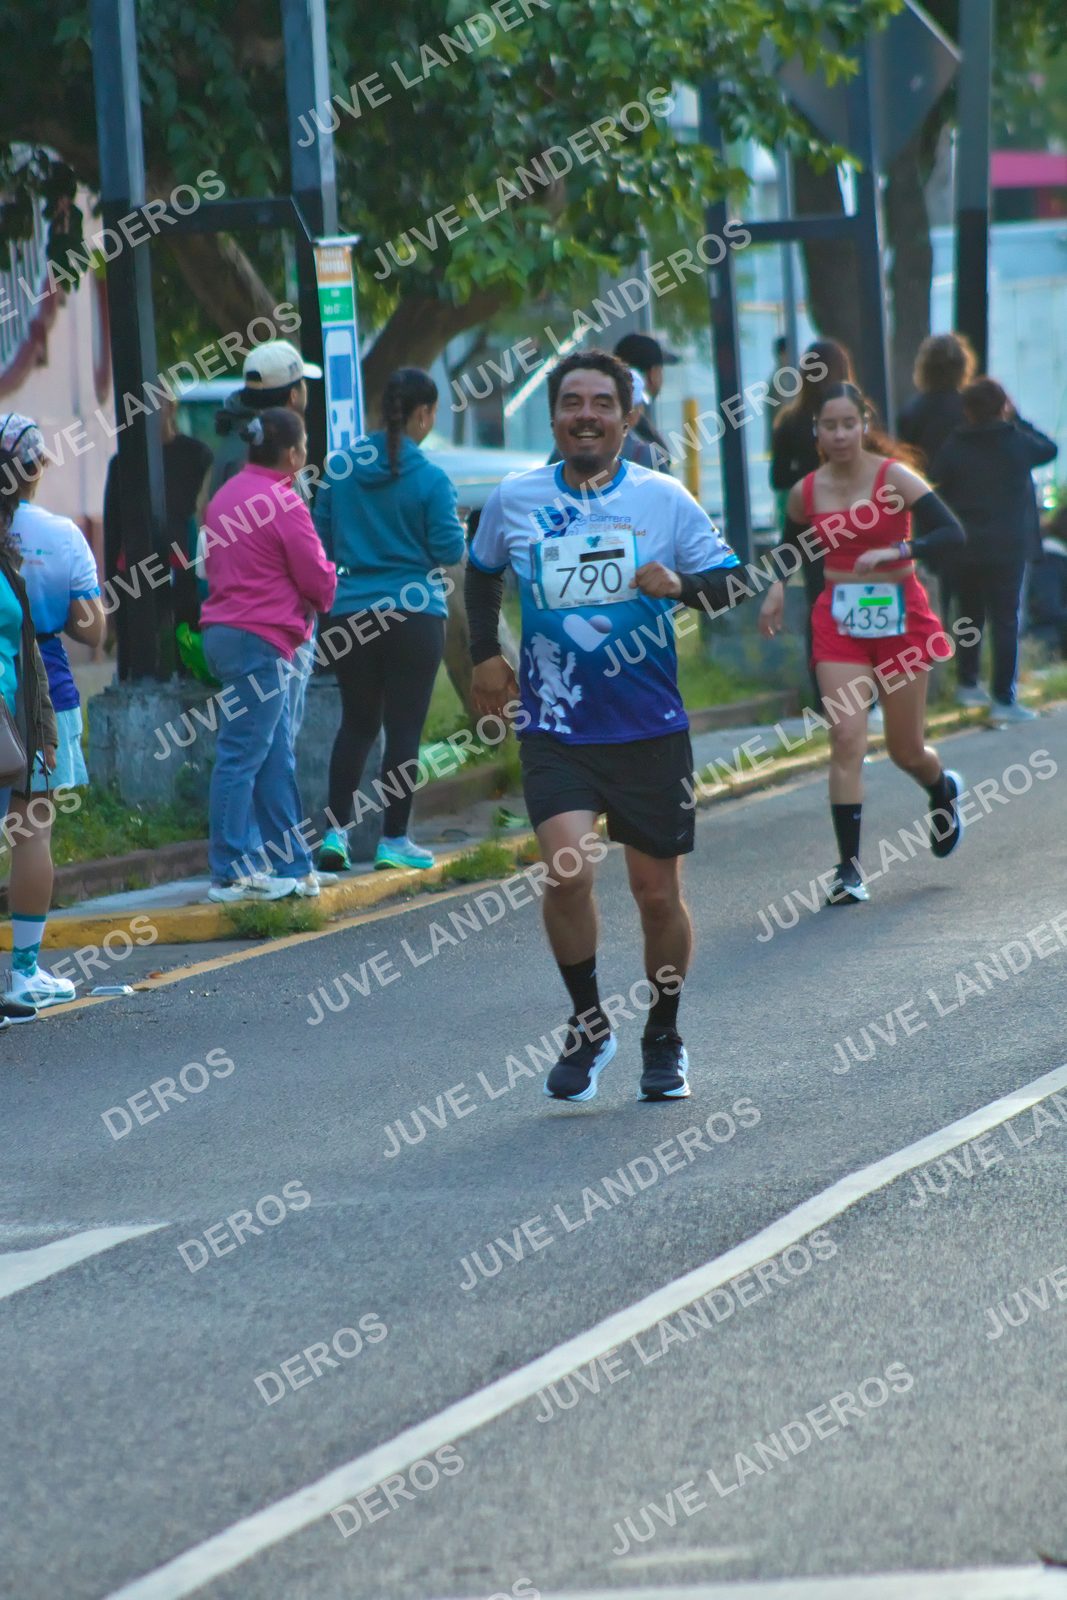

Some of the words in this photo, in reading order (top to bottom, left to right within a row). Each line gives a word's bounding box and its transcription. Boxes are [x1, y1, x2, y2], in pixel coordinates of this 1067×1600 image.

[590, 513, 632, 523] Carrera
[556, 562, 622, 598] 790
[843, 606, 889, 630] 435
